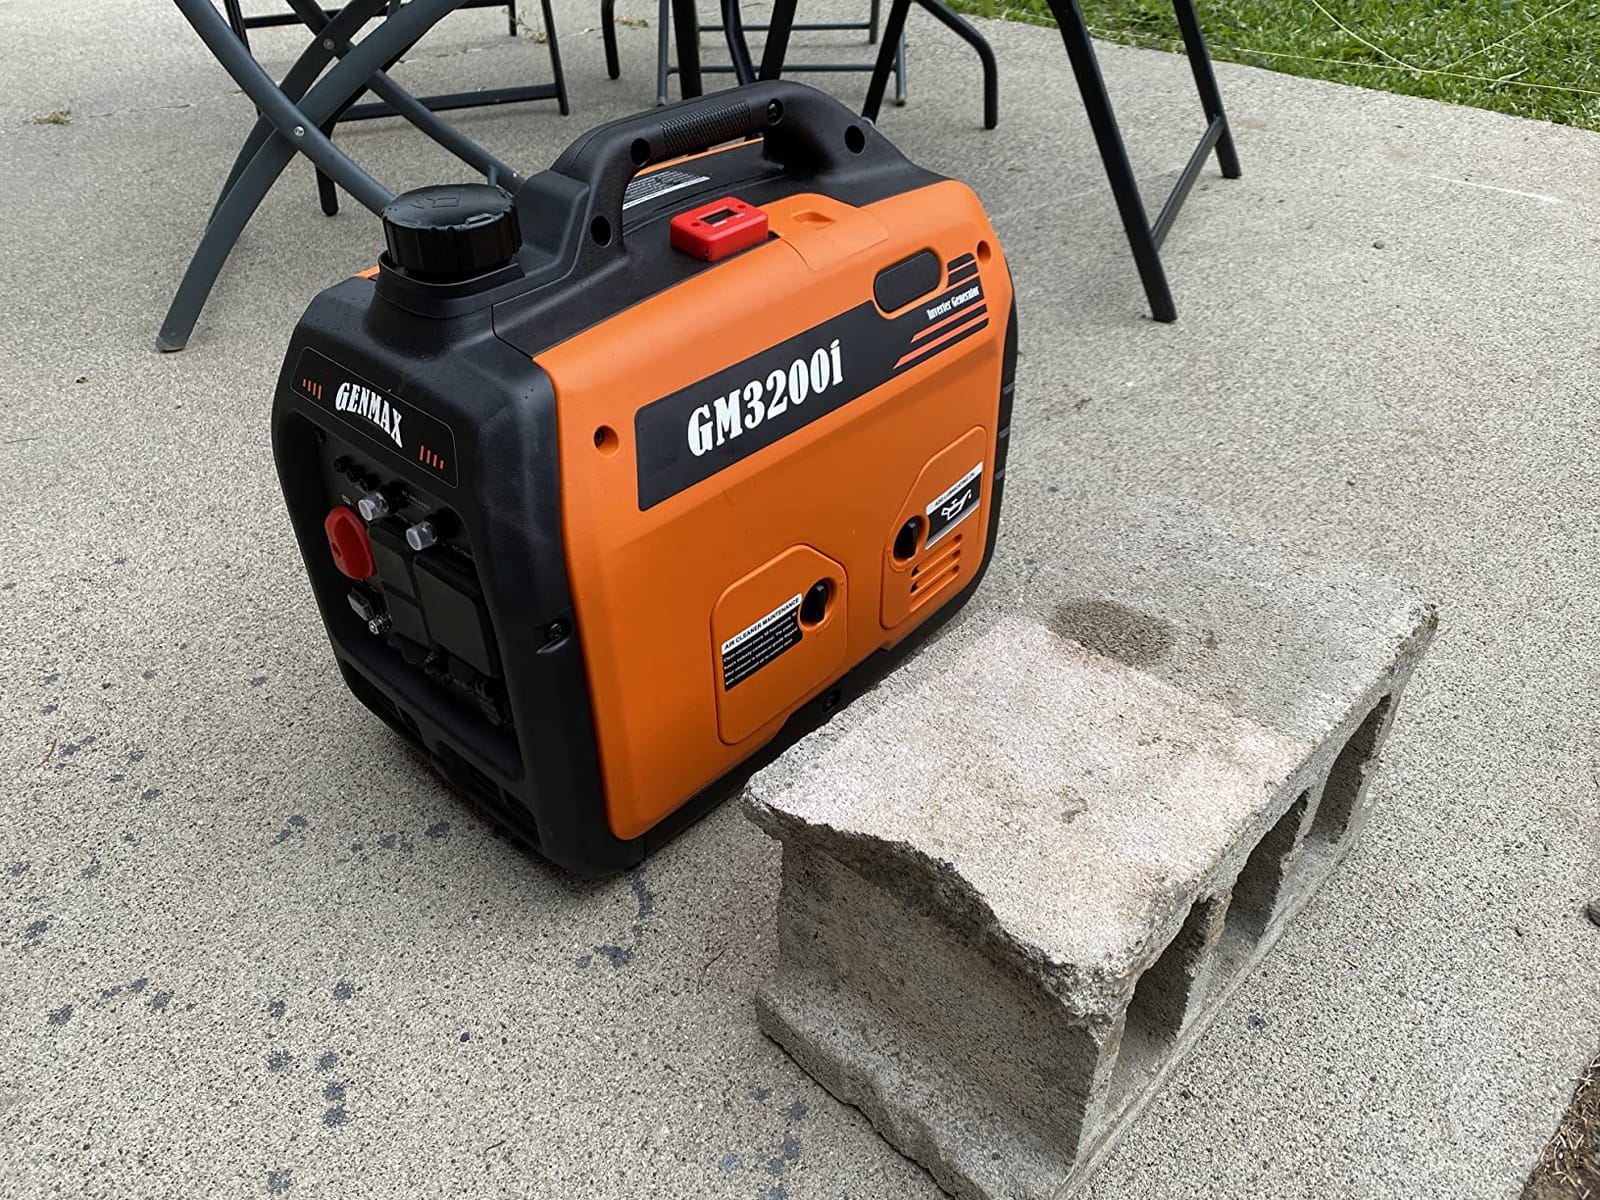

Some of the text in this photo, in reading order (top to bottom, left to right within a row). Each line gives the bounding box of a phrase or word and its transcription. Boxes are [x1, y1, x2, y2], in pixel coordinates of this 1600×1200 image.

[926, 286, 980, 320] Inverter Generator
[335, 382, 403, 448] GENMAX
[687, 338, 843, 457] GM3200i
[724, 639, 736, 651] AIR
[735, 621, 762, 644] CLEANER
[762, 597, 799, 625] MAINTENANCE
